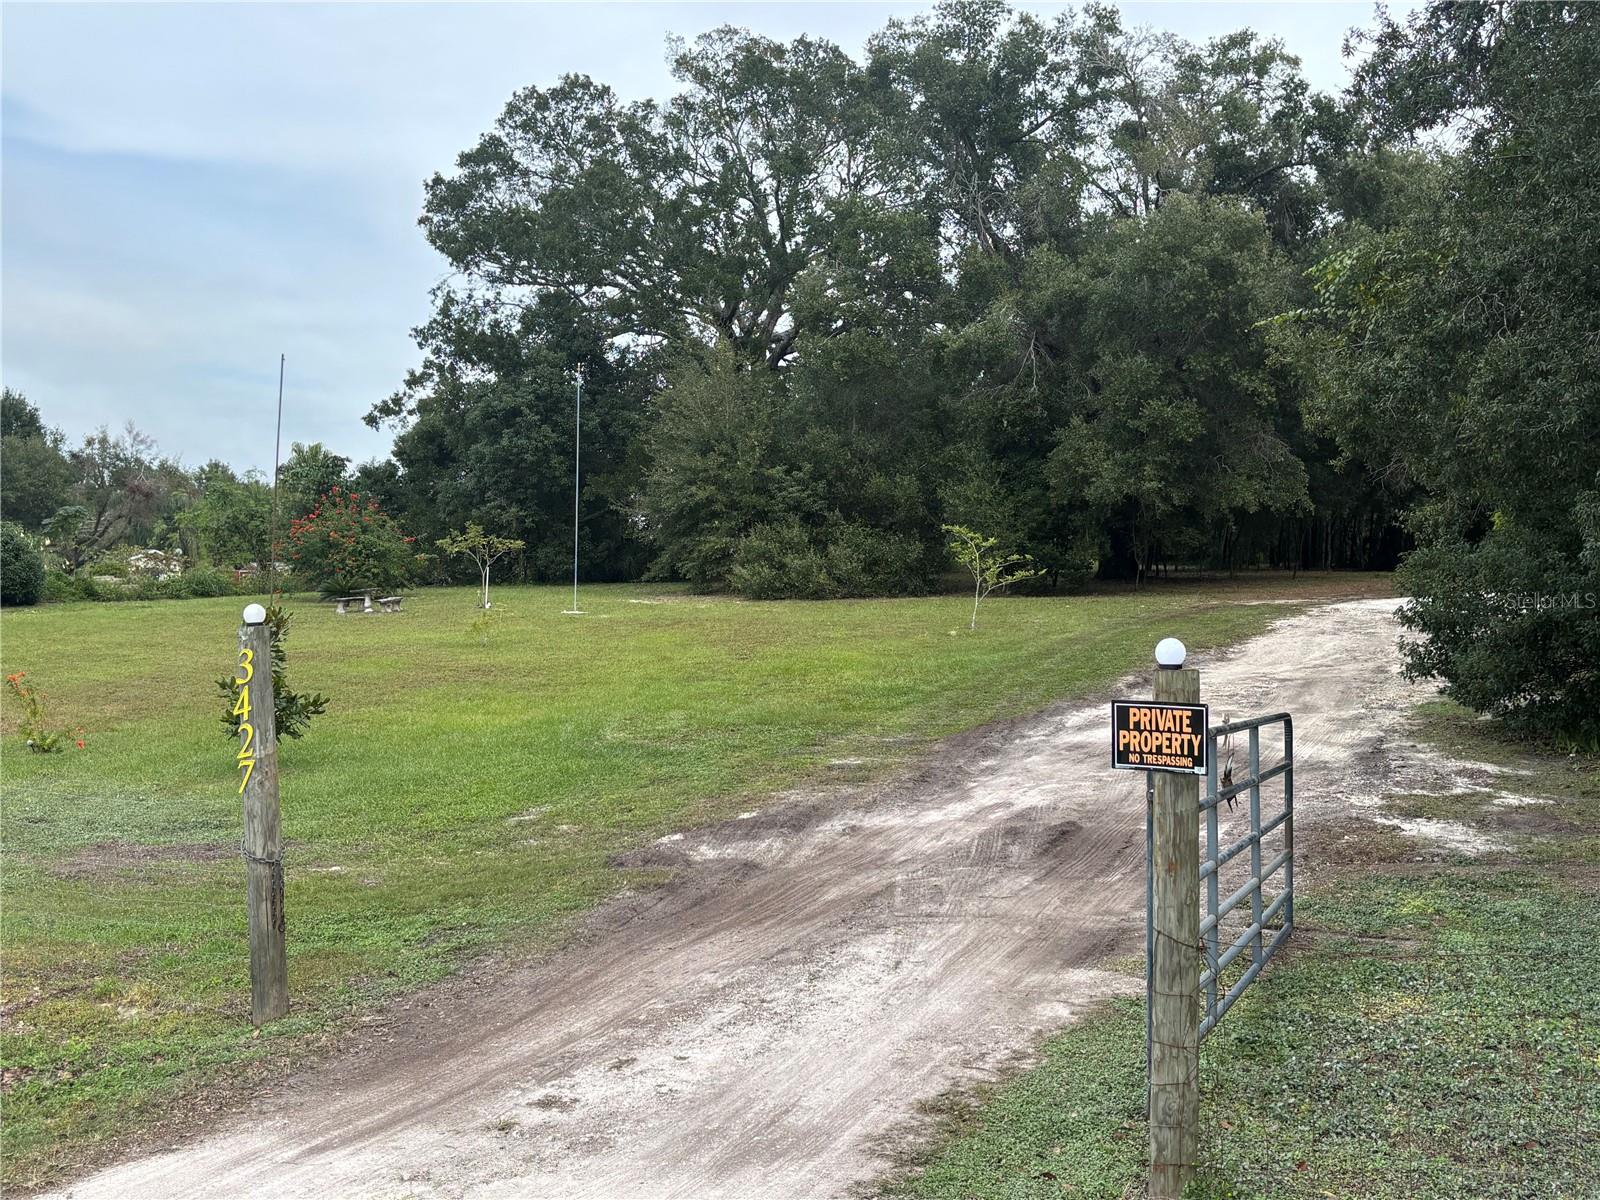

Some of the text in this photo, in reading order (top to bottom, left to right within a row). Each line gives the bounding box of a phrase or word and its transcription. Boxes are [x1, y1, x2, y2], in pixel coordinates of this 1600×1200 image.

[233, 648, 256, 794] 3427
[1129, 707, 1192, 733] PRIVATE
[1119, 729, 1202, 756] PROPERTY
[1128, 752, 1193, 768] NO TRESPASSING
